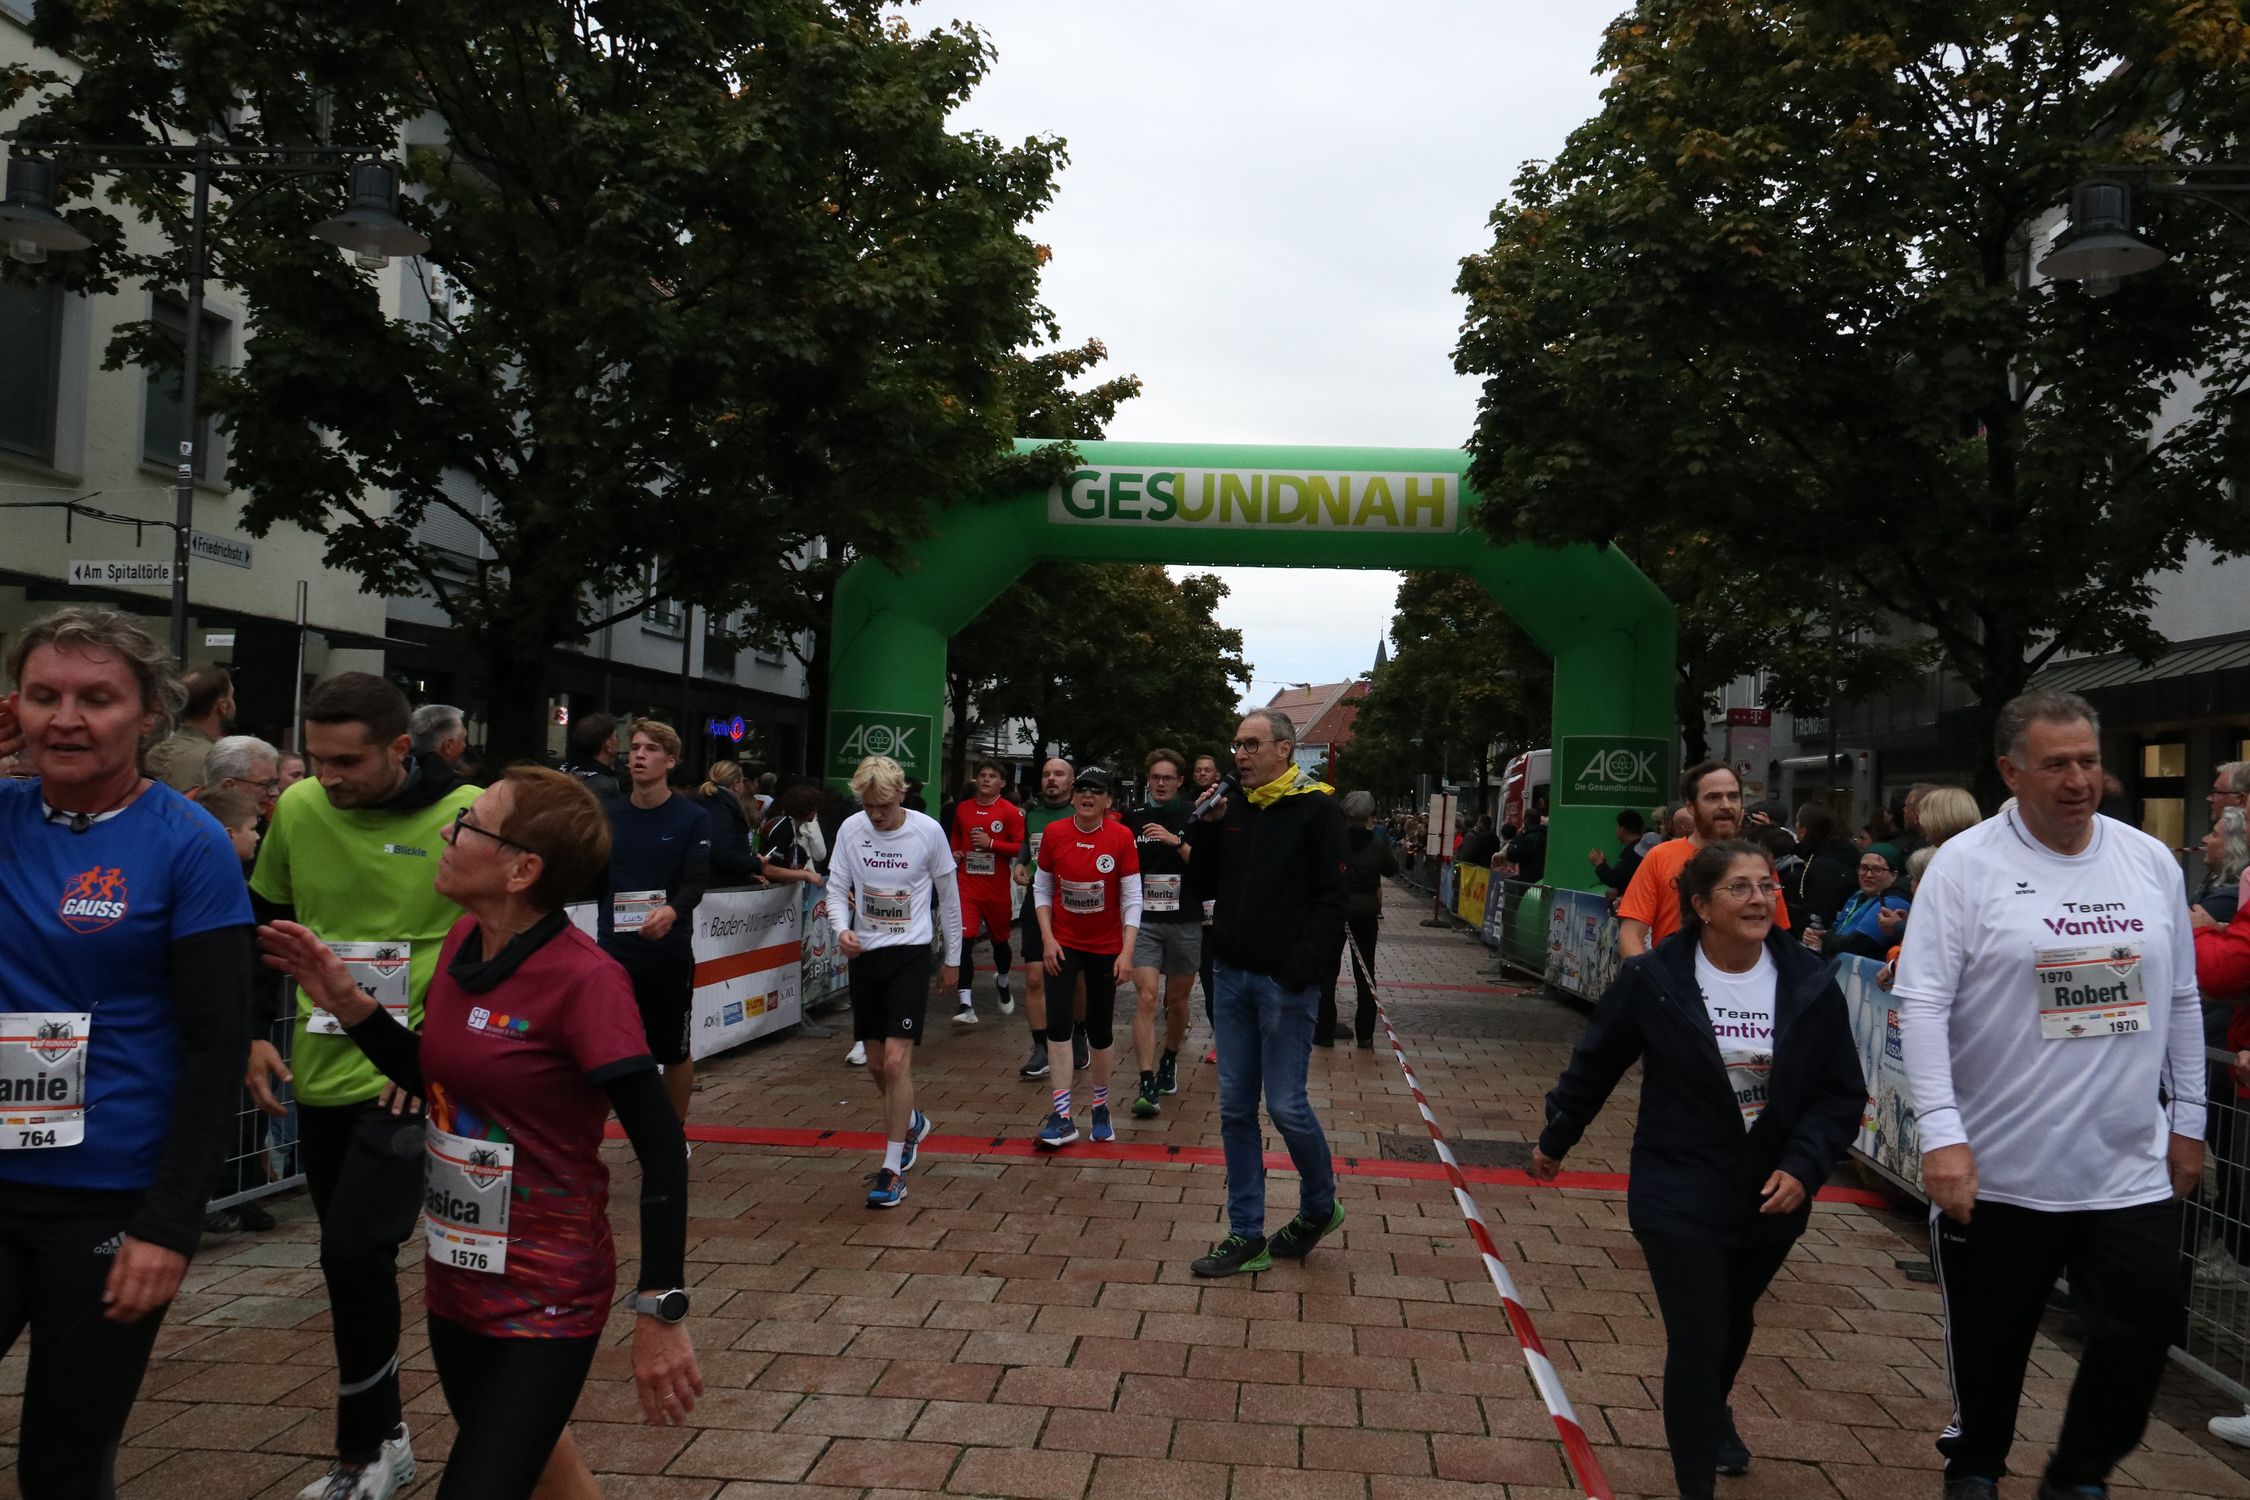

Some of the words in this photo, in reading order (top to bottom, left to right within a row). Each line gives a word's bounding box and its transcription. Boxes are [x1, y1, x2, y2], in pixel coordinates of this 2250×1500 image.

[198, 536, 244, 562] Friedrichstr.
[84, 564, 102, 579] Am
[108, 564, 169, 582] Spitaltörle
[840, 724, 917, 759] AOK
[1577, 748, 1658, 784] AOK
[874, 850, 903, 858] Team
[863, 857, 909, 870] Vantive
[968, 862, 990, 871] Florian
[1064, 895, 1100, 908] Annette
[1147, 889, 1174, 899] Moritz
[62, 898, 126, 919] GAUSS
[866, 903, 903, 918] Marvin
[2062, 902, 2126, 914] Team
[2042, 914, 2145, 937] Vantive
[2039, 970, 2073, 984] 1970
[2055, 981, 2129, 1007] Robert
[1713, 1007, 1769, 1021] Team
[2109, 1019, 2139, 1033] 1970
[19, 1130, 56, 1147] 764
[450, 1248, 488, 1270] 1576
